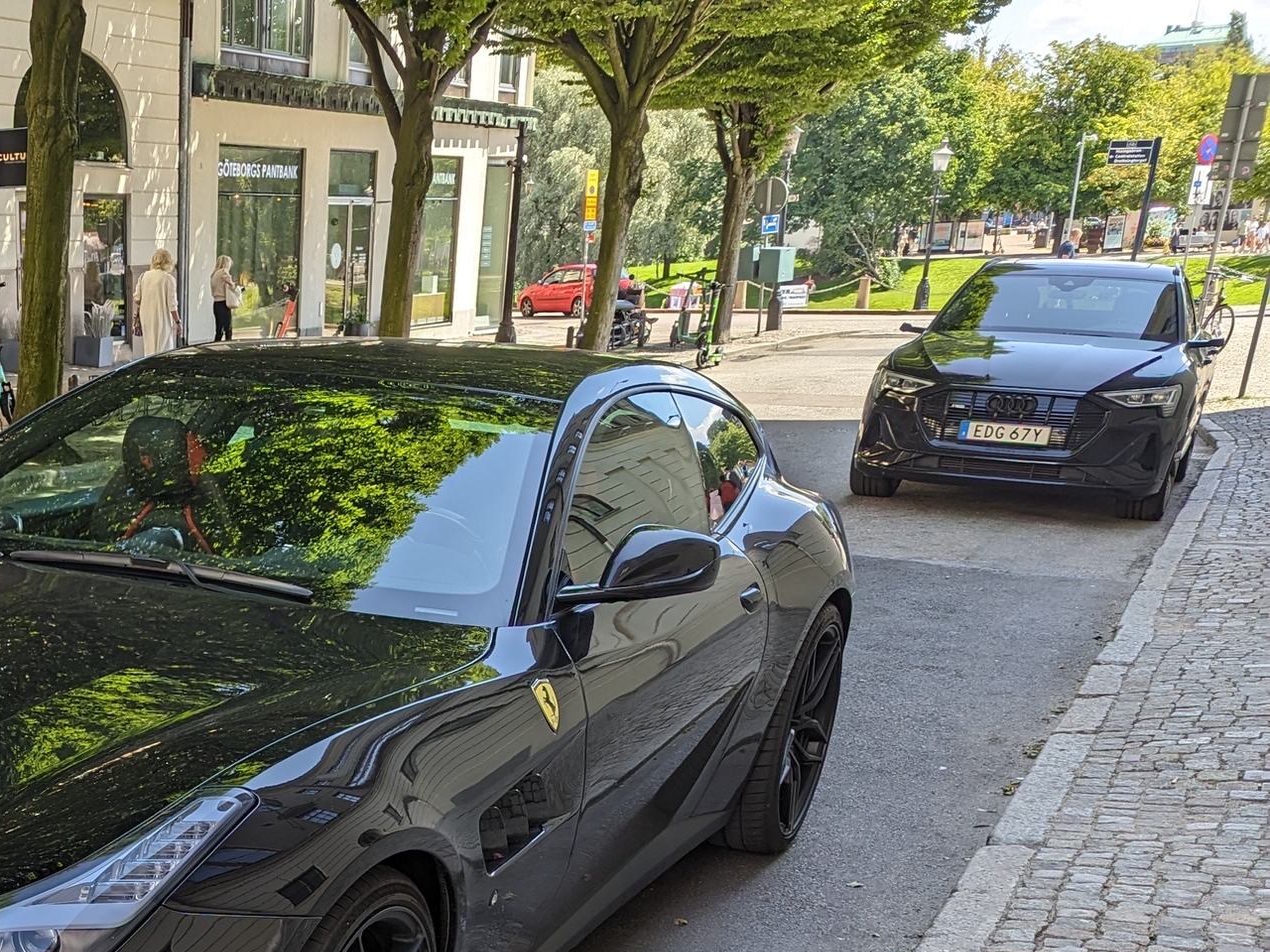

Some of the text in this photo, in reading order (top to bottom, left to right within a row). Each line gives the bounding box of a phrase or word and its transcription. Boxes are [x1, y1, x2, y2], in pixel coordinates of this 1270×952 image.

[217, 158, 299, 179] GÖTEBORGS PANTBANK
[973, 424, 1043, 442] EDG 67Y
